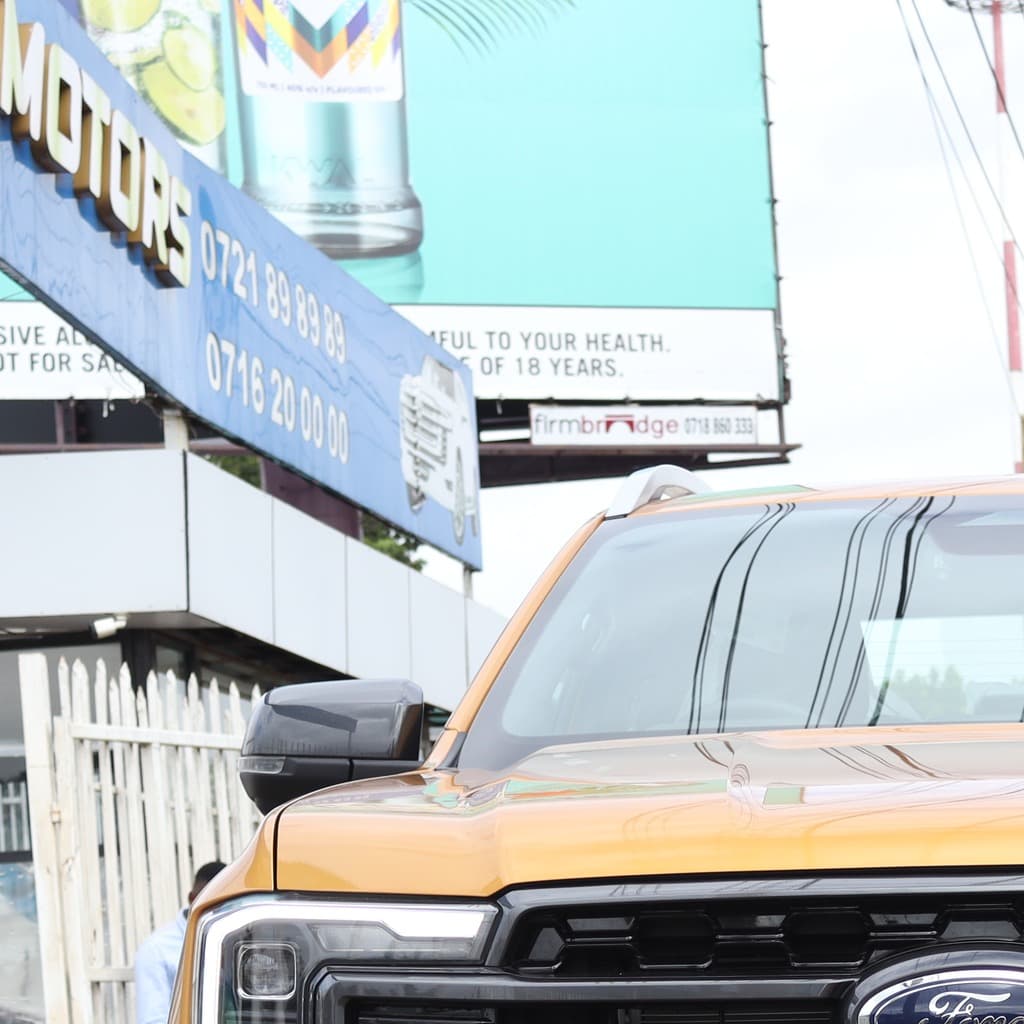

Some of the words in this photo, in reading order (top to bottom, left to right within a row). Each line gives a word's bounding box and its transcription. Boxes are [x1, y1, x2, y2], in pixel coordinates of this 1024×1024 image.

[0, 0, 193, 289] MOTORS
[201, 220, 259, 308] 0721
[265, 261, 292, 327] 89
[296, 283, 321, 347] 89
[324, 303, 346, 364] 89
[56, 326, 93, 346] AL
[486, 331, 511, 350] TO
[520, 332, 577, 351] YOUR
[586, 333, 671, 353] HEALTH.
[30, 352, 71, 373] FOR
[480, 357, 504, 376] OF
[516, 357, 541, 376] 18
[549, 358, 624, 377] YEARS.
[206, 331, 265, 415] 0716
[271, 368, 296, 432] 20
[301, 386, 324, 449] 00
[328, 404, 348, 464] 00
